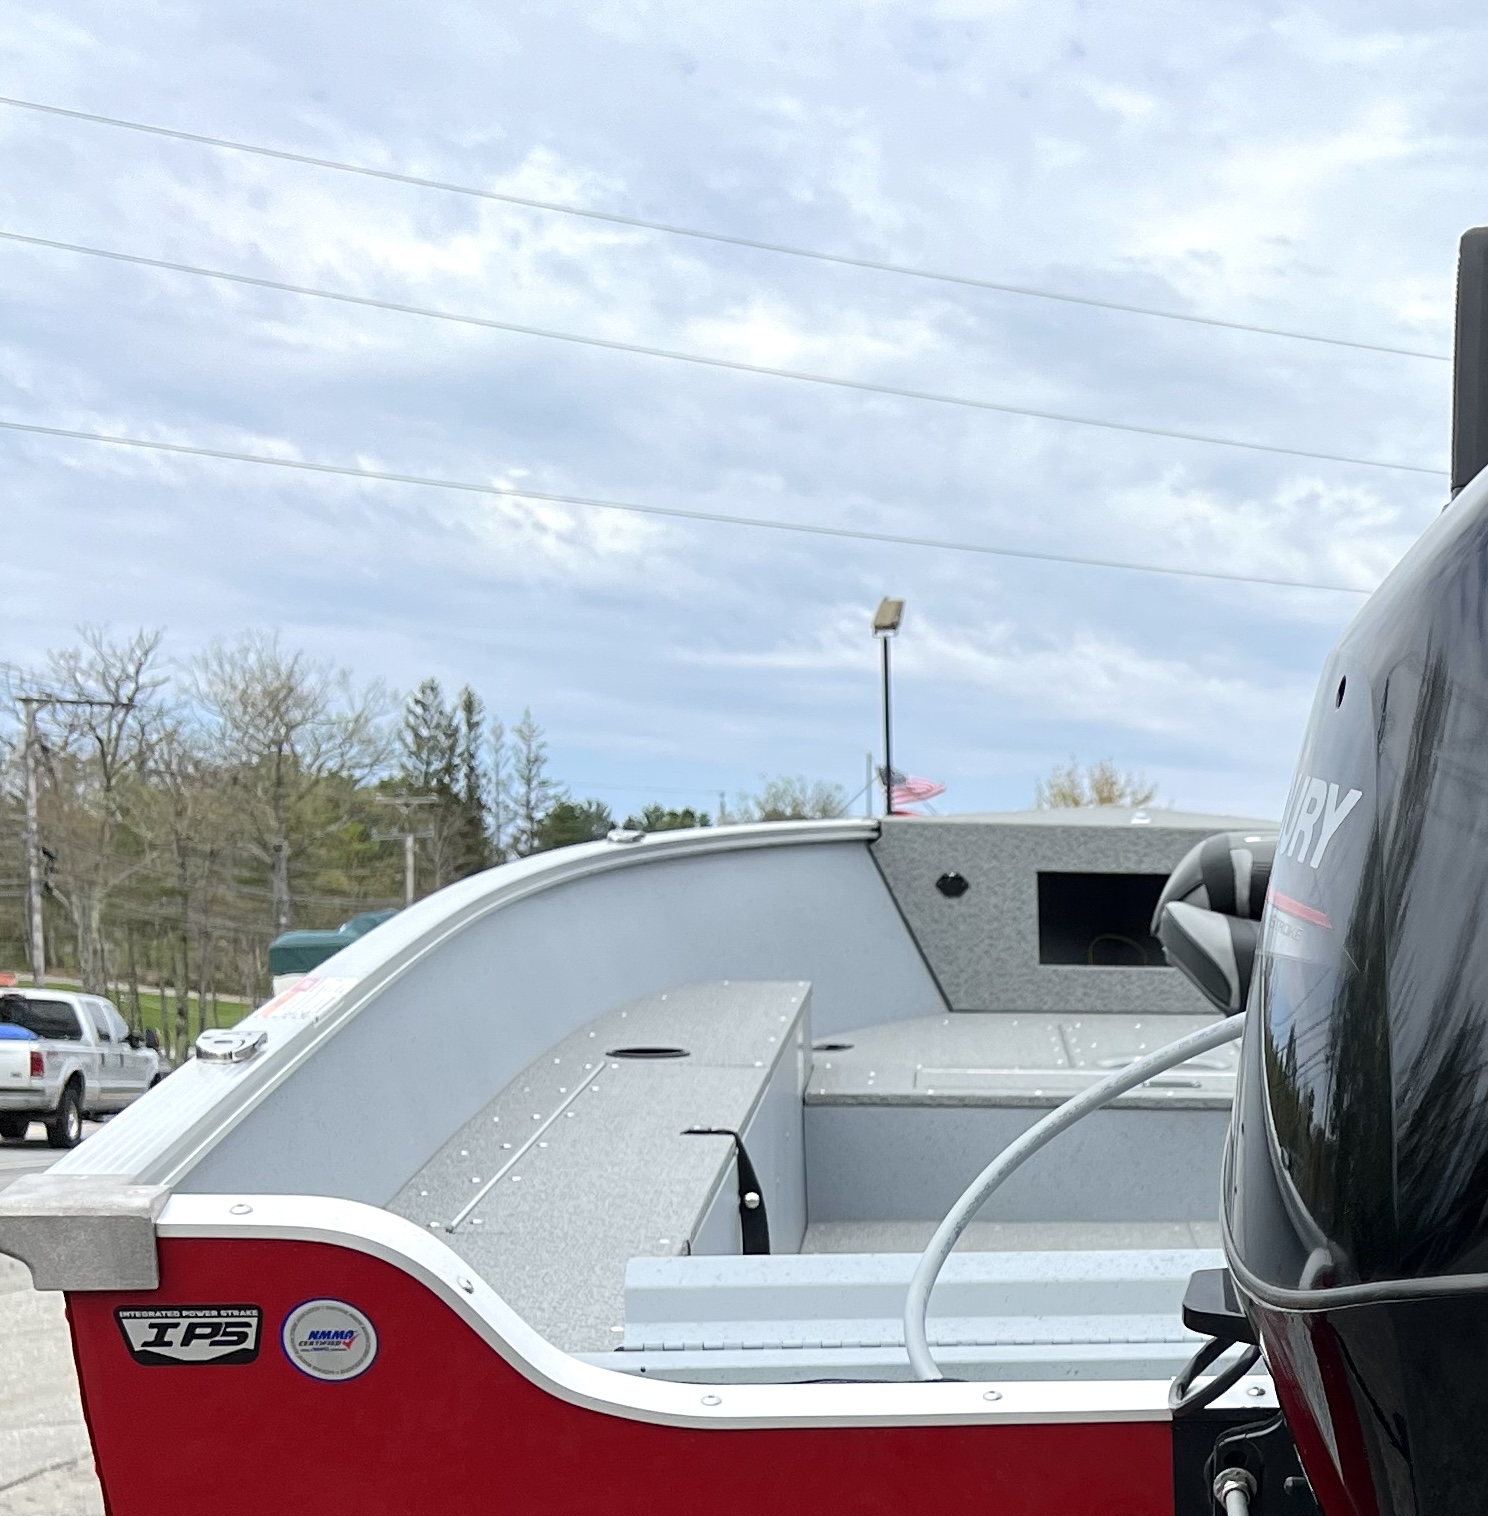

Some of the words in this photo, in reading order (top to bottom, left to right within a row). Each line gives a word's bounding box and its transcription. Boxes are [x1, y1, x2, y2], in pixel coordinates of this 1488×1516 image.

[119, 1310, 180, 1318] INTEGRATED
[220, 1309, 259, 1317] STRAKE
[140, 1321, 253, 1348] IPS
